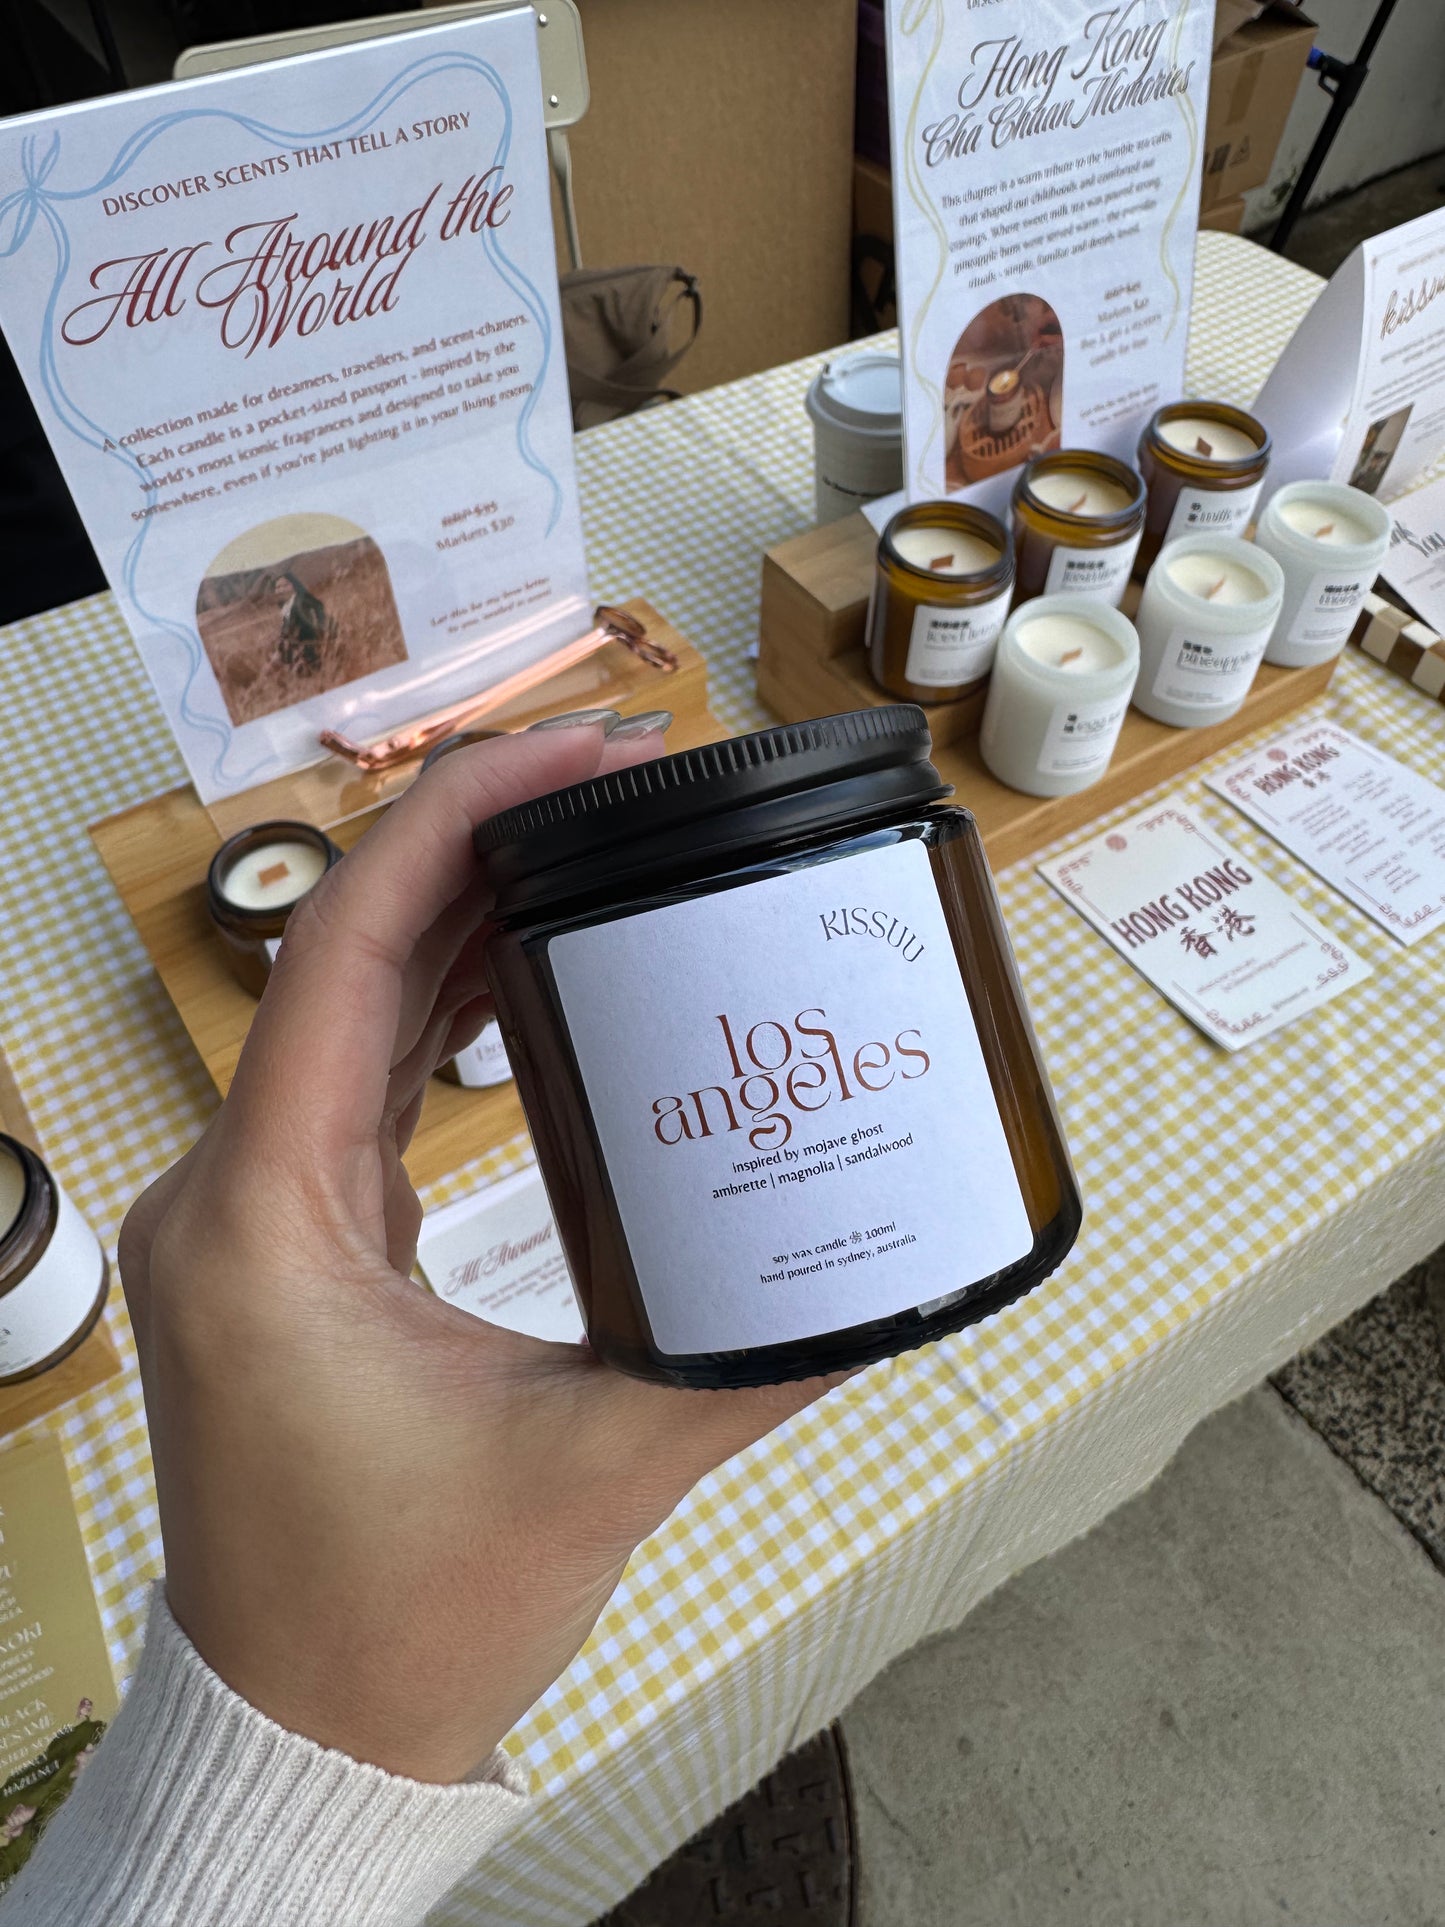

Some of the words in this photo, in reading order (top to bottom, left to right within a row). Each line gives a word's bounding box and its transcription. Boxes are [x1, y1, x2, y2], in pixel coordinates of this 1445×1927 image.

[958, 35, 1070, 110] Hong
[1071, 0, 1169, 83] Kong
[922, 112, 984, 168] Cha
[1071, 59, 1197, 129] Memories
[102, 175, 210, 217] DISCOVER
[213, 154, 289, 189] SCENTS
[293, 142, 344, 168] THAT
[350, 130, 392, 156] TELL
[394, 126, 410, 144] A
[411, 111, 471, 142] STORY
[61, 241, 213, 346] All
[196, 183, 443, 308] Around
[439, 165, 515, 241] the
[220, 251, 416, 360] World
[103, 438, 117, 453] A
[119, 415, 194, 449] collection
[197, 401, 239, 424] made
[242, 392, 264, 409] for
[267, 372, 339, 402] dreamers,
[341, 350, 408, 379] travellers,
[411, 337, 437, 357] and
[136, 446, 175, 469] Each
[177, 431, 225, 456] candle
[228, 425, 242, 439] is
[246, 423, 255, 435] a
[258, 391, 346, 434] pocket-sized
[350, 374, 408, 404] passport
[420, 352, 473, 380] inspired
[475, 348, 491, 364] by
[494, 340, 516, 356] the
[197, 454, 235, 475] most
[238, 439, 280, 462] iconic
[283, 415, 354, 448] fragrances
[358, 403, 383, 424] and
[385, 384, 446, 415] designed
[447, 379, 463, 395] to
[465, 371, 494, 389] take
[496, 363, 520, 381] you
[223, 470, 258, 492] even
[259, 463, 271, 479] if
[319, 442, 346, 463] just
[347, 425, 400, 452] lighting
[402, 420, 413, 433] it
[414, 415, 429, 429] in
[430, 405, 460, 424] your
[818, 907, 925, 963] KISSUU
[1110, 894, 1189, 950] HONG
[1176, 858, 1255, 914] KONG
[1180, 904, 1258, 960] 香港
[651, 1029, 931, 1151] angeles
[716, 1008, 834, 1081] los
[712, 1176, 768, 1200] ambrette
[777, 1160, 836, 1189] magnolia
[844, 1133, 914, 1167] sandalwood
[732, 1150, 782, 1175] inspired
[784, 1146, 800, 1163] by
[803, 1133, 848, 1163] mojave
[850, 1122, 885, 1150] ghost
[760, 1266, 785, 1284] hand
[787, 1260, 823, 1282] poured
[824, 1257, 835, 1270] in
[837, 1247, 876, 1268] sydney,
[877, 1232, 917, 1254] australia
[772, 1253, 790, 1266] soy
[791, 1247, 813, 1259] wax
[814, 1236, 847, 1255] candle
[865, 1221, 897, 1243] 100ml
